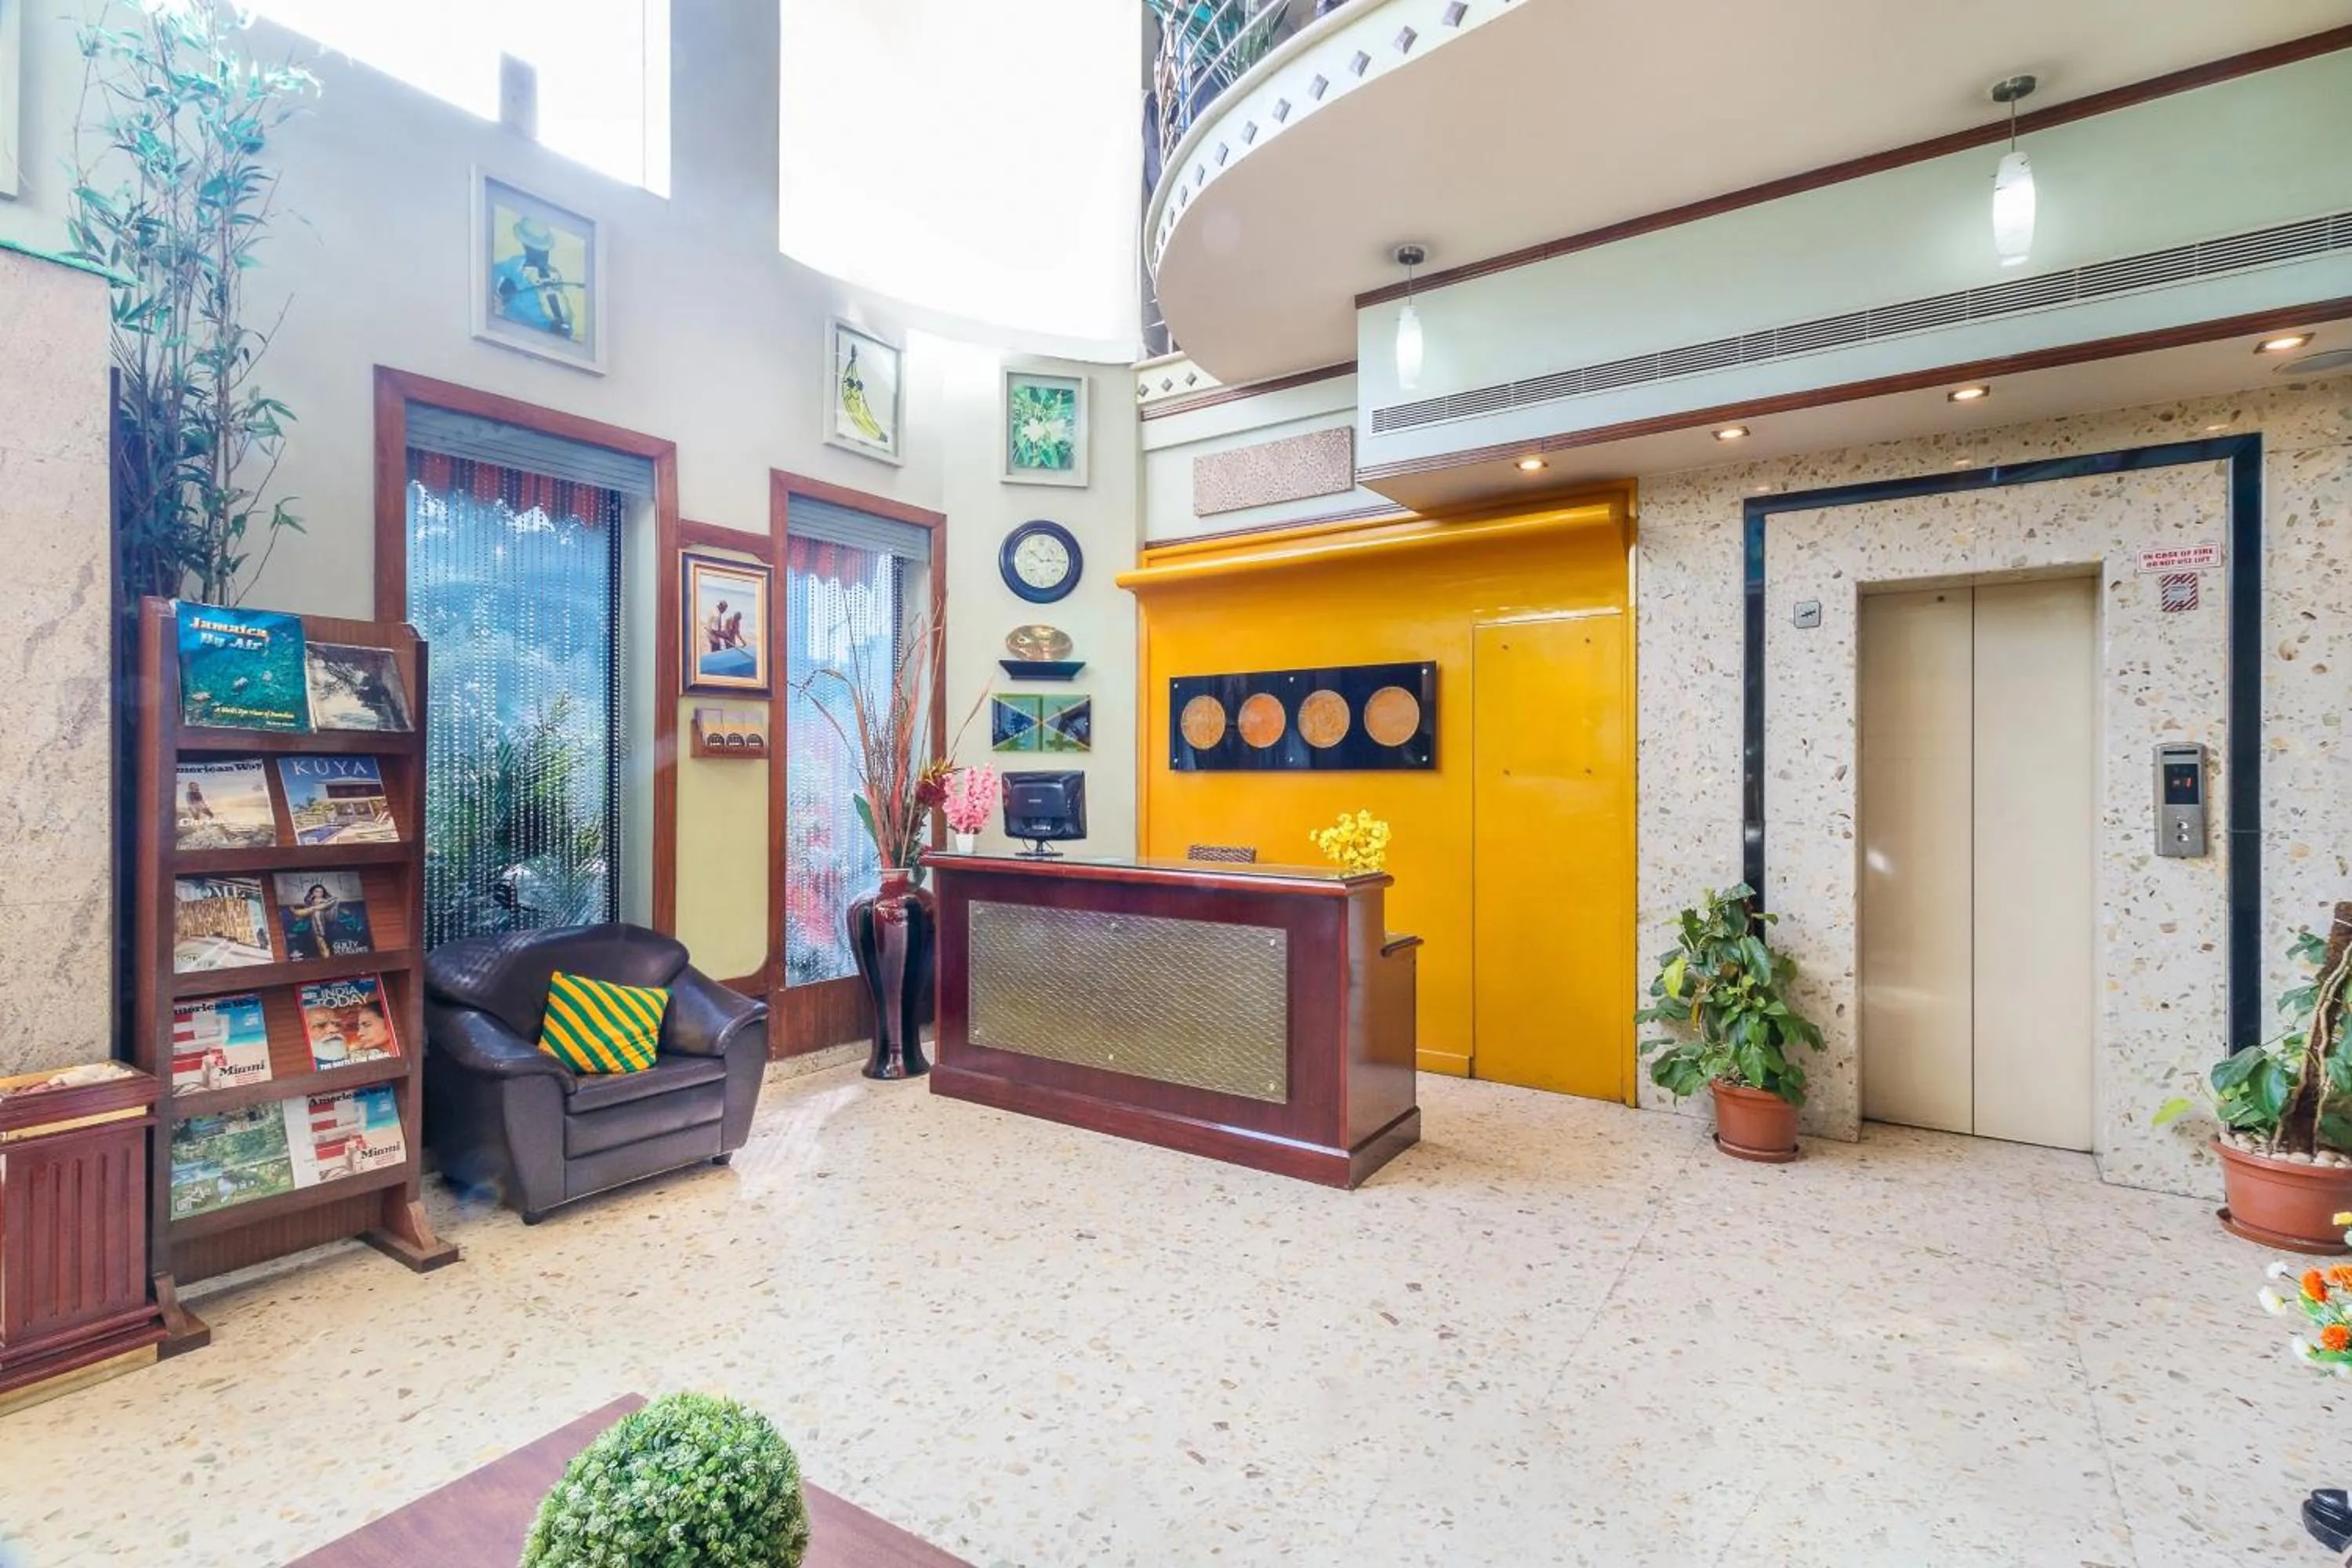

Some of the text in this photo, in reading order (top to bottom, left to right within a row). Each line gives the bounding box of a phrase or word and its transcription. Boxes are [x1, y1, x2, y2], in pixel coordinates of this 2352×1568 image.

[189, 617, 269, 639] Jamaica
[200, 632, 225, 648] By
[292, 760, 368, 775] KUYA
[321, 985, 358, 1000] INDIA
[316, 992, 369, 1009] TODAY
[174, 1003, 231, 1014] merican
